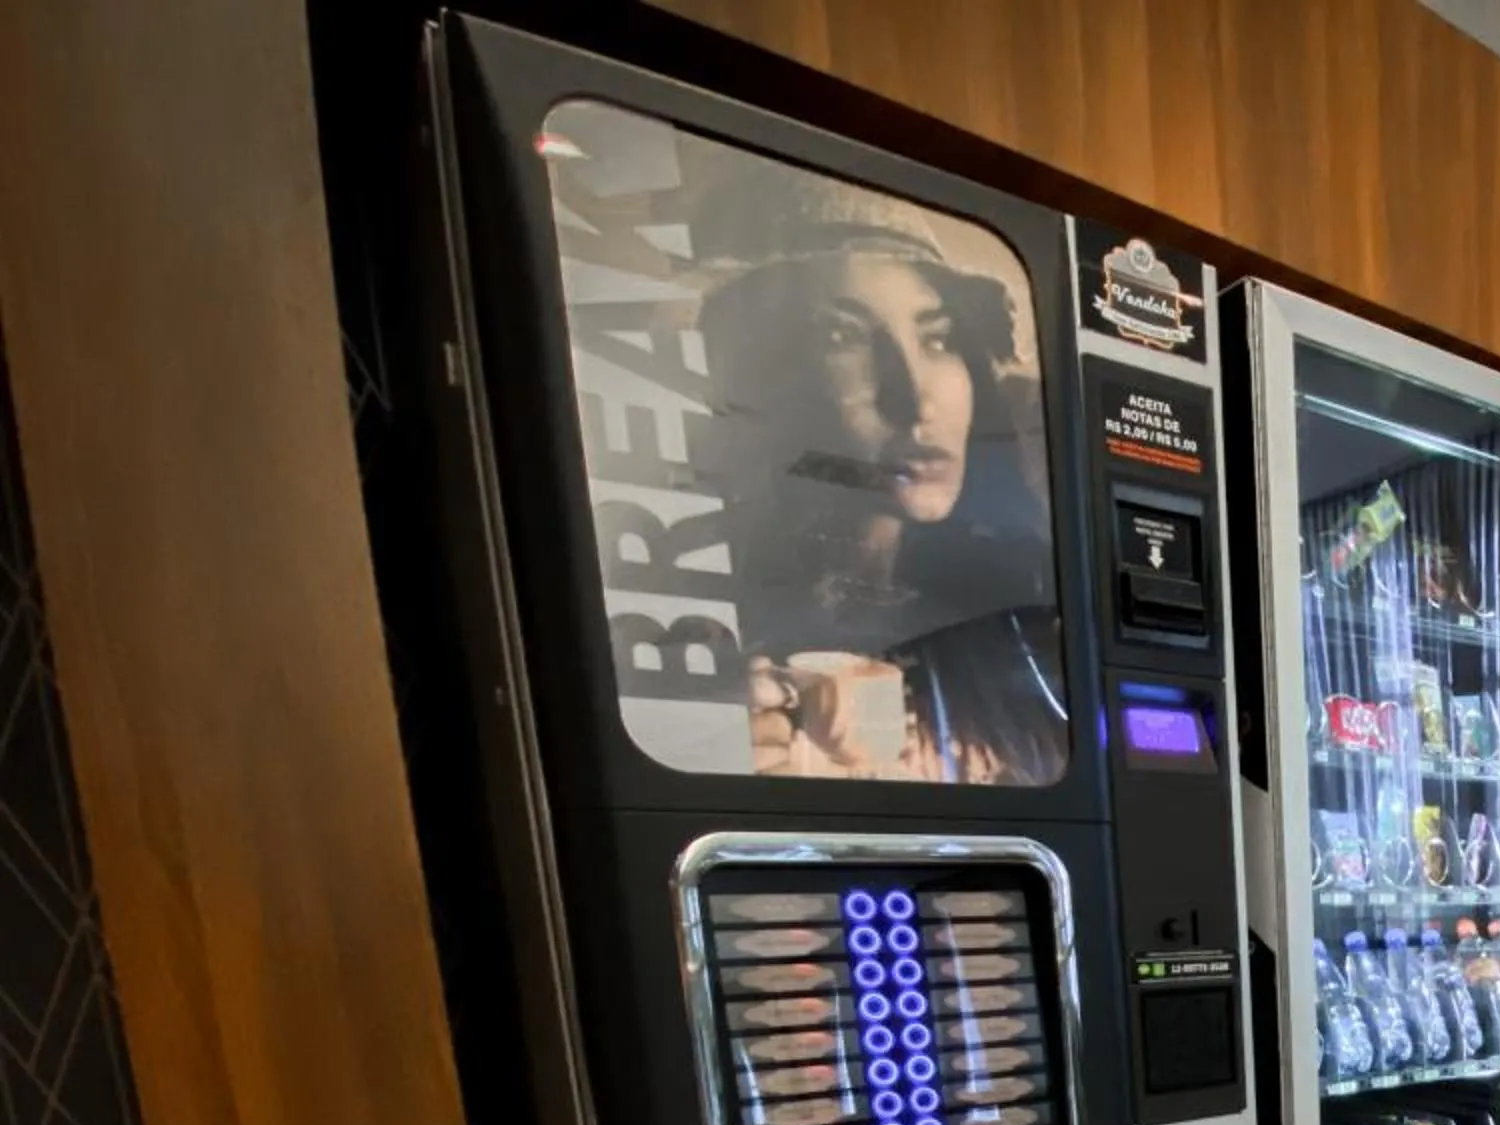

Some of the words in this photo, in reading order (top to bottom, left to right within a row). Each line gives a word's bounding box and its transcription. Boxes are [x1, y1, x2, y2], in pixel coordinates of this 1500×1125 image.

[1128, 394, 1172, 416] ACEITA
[550, 163, 748, 703] BREAK
[1121, 407, 1162, 429] NOTAS
[1163, 418, 1181, 433] DE
